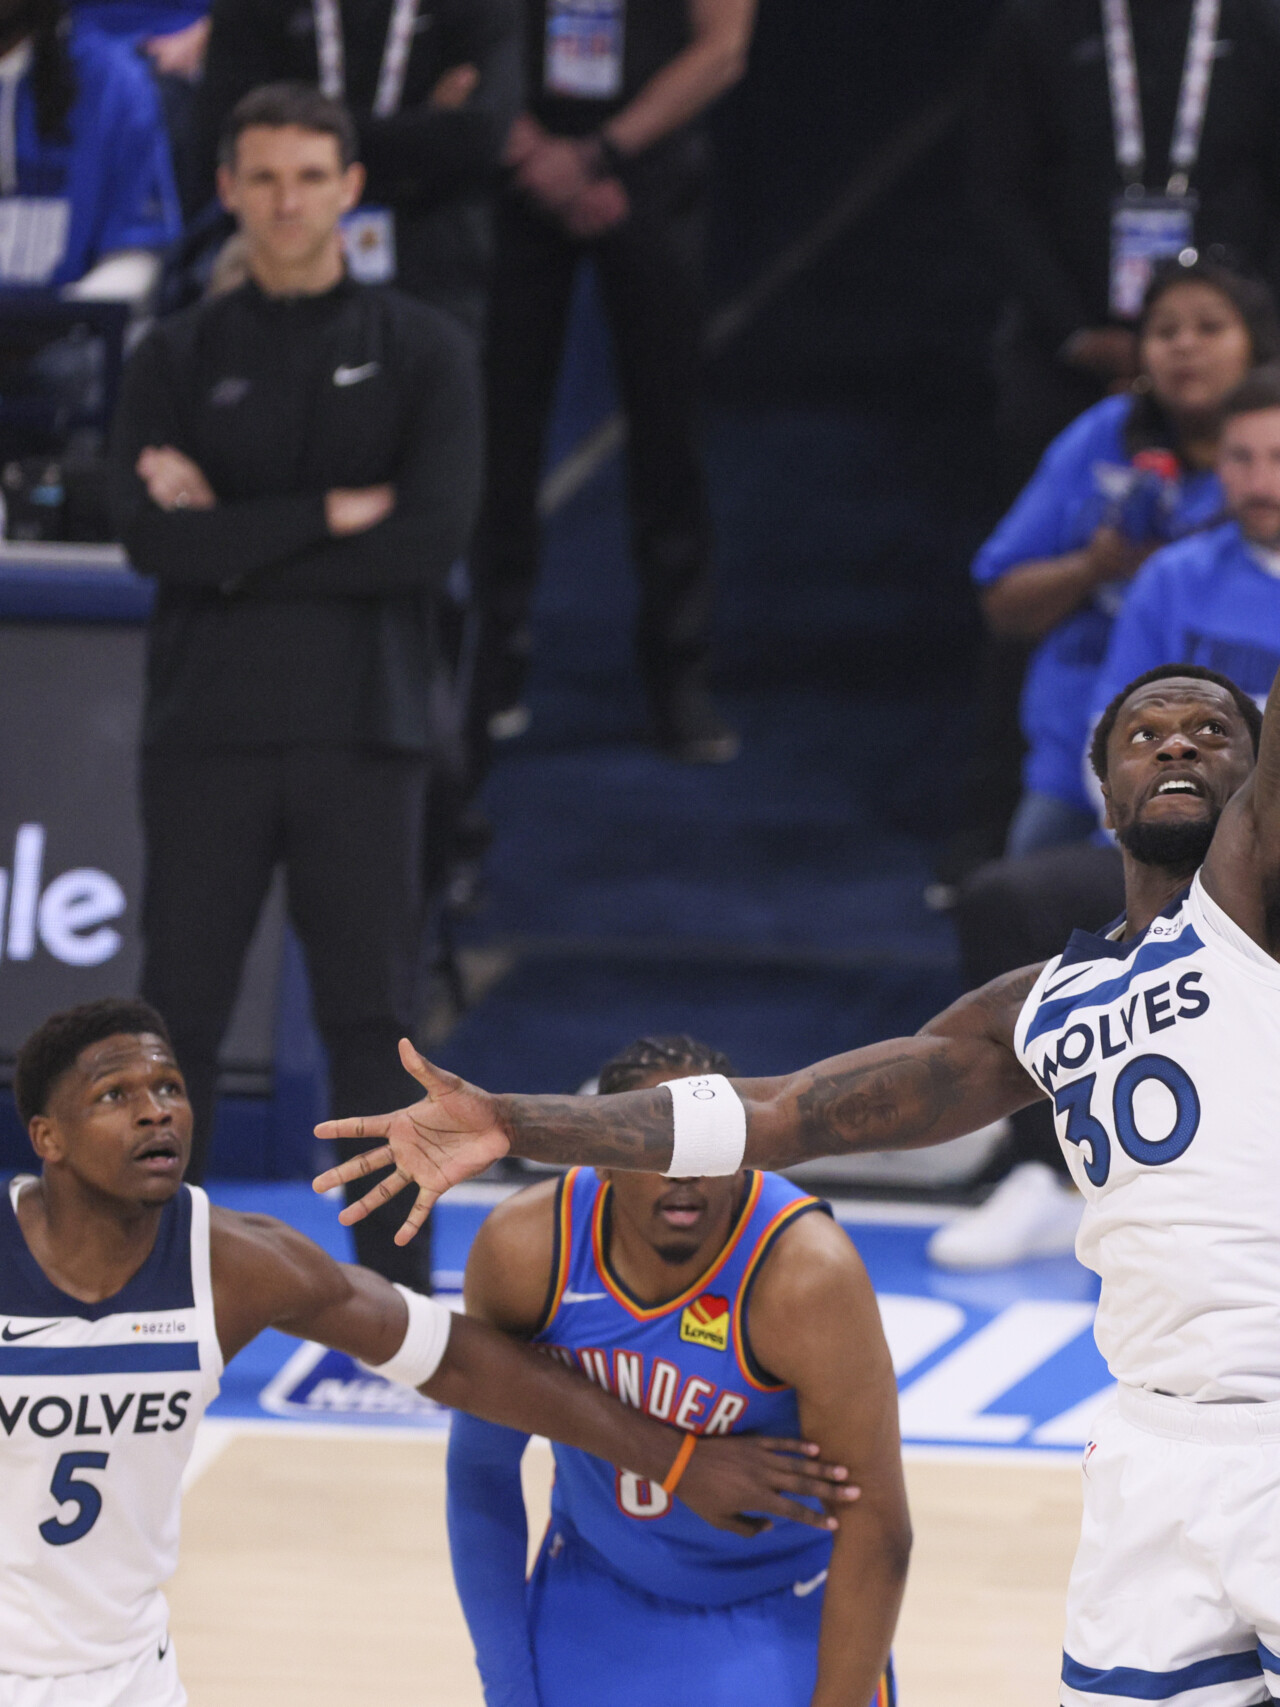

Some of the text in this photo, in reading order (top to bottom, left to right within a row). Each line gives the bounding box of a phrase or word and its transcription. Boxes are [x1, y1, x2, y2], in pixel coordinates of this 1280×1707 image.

[1032, 971, 1210, 1097] WOLVES
[1053, 1053, 1201, 1188] 30
[38, 1450, 110, 1546] 5
